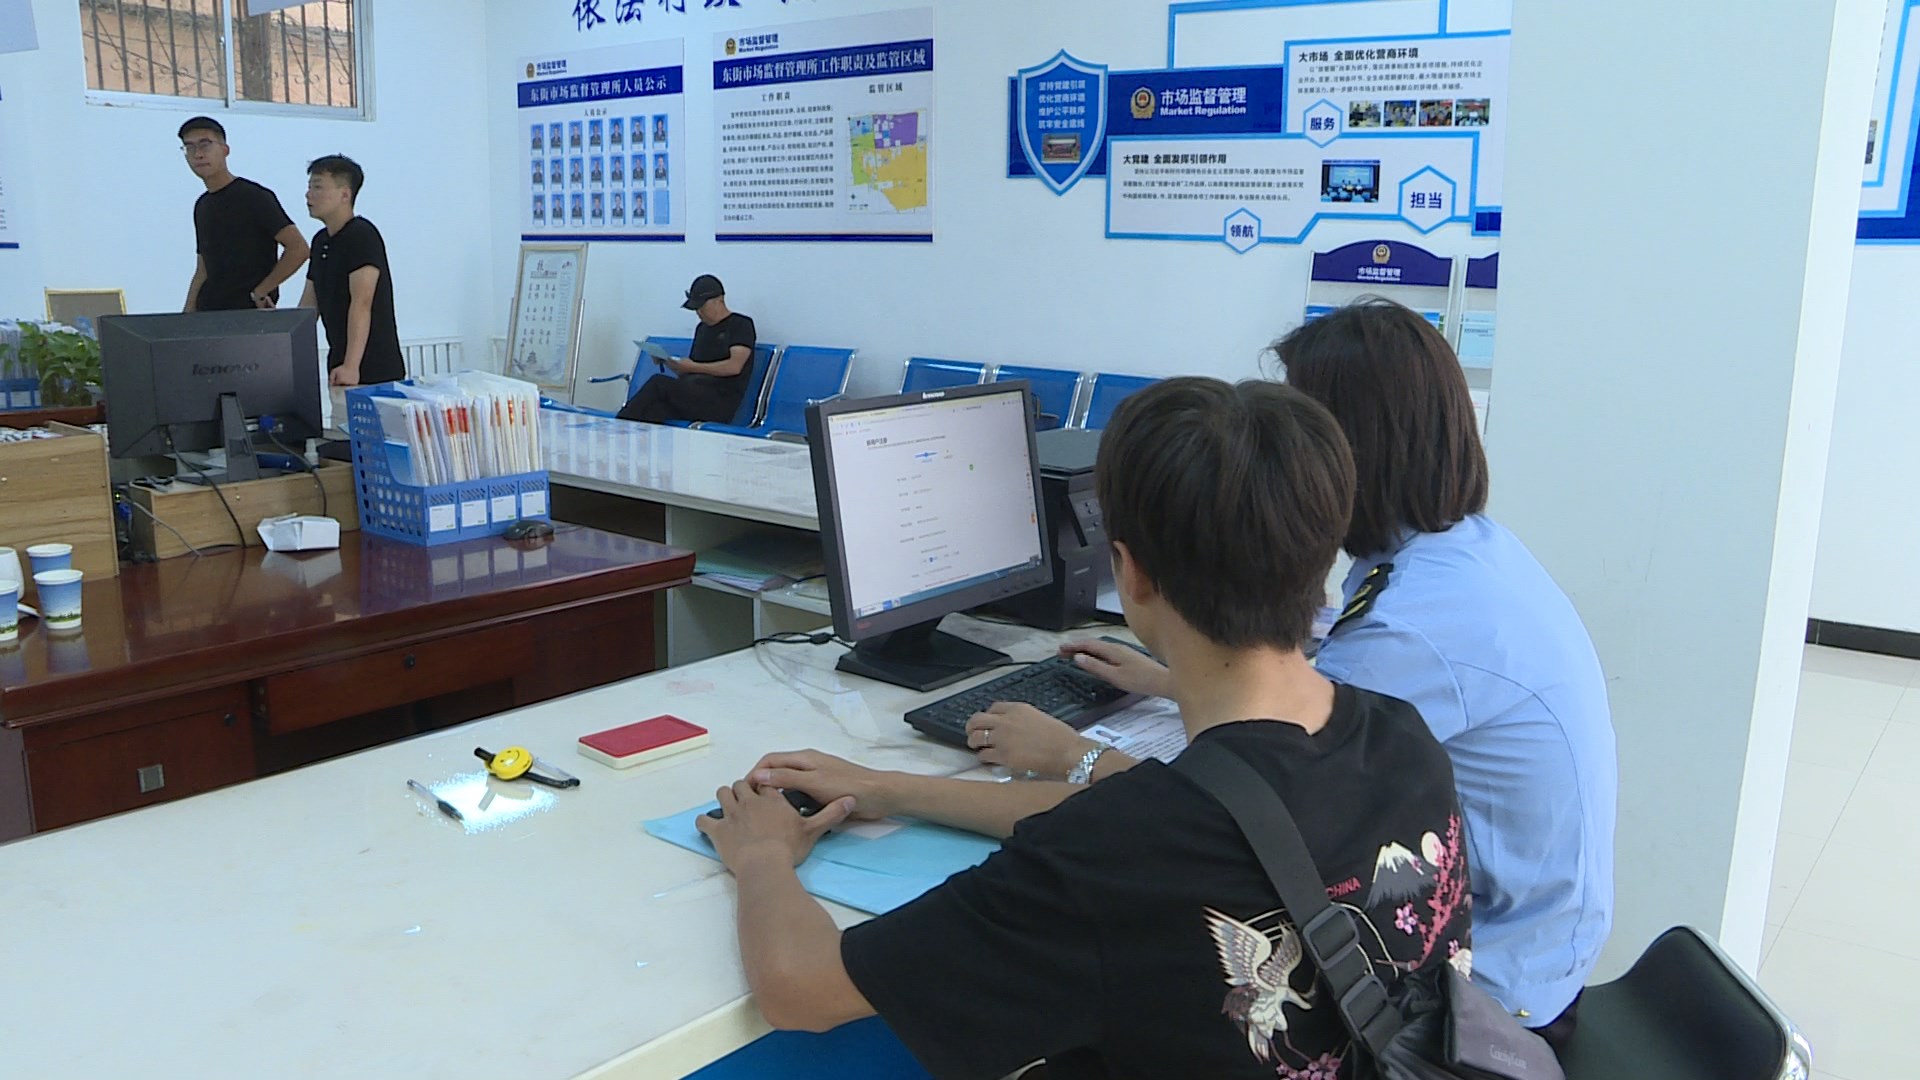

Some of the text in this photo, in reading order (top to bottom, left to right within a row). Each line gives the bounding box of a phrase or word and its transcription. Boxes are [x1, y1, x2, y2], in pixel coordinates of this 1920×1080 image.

[1299, 47, 1419, 63] 大市场 全面优化营商环境
[722, 48, 926, 83] 东街市场监督管理所工作职责及监管区域
[530, 74, 667, 102] 东街市场监督管理所人员公示
[869, 82, 903, 94] 监管区域
[1160, 87, 1246, 105] 市场监督管理
[1160, 105, 1246, 117] Market Regulation
[1310, 117, 1335, 131] 服务
[1123, 154, 1227, 164] 大党建 全面发挥引领作用
[1410, 192, 1442, 209] 担当
[1230, 224, 1255, 238] 领航
[1325, 876, 1361, 899] CHINA
